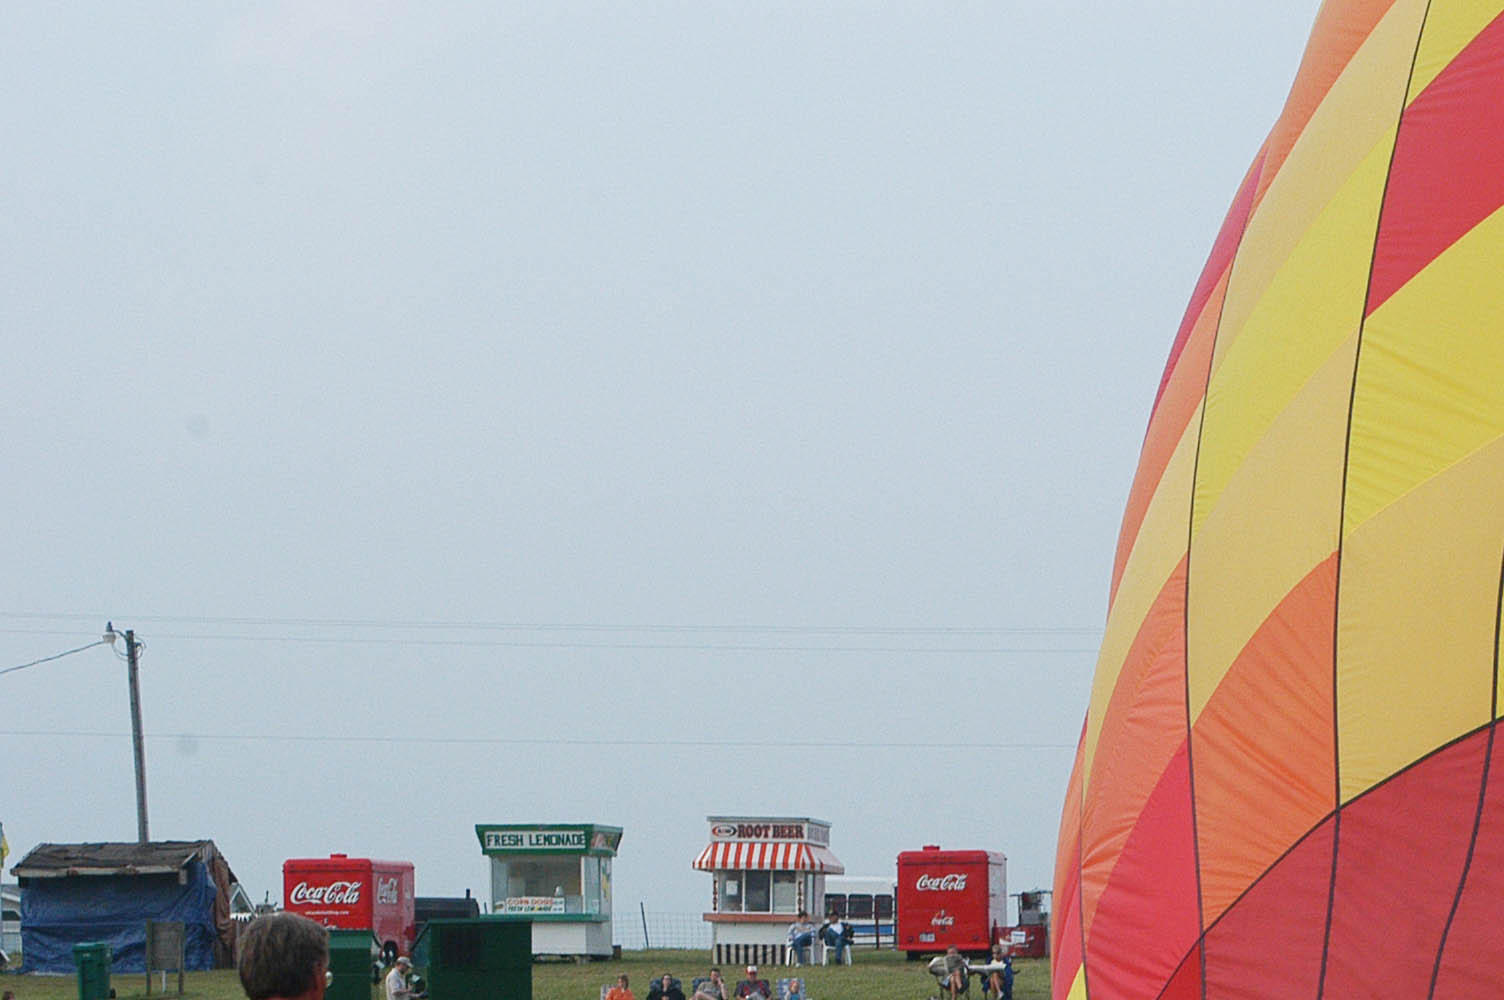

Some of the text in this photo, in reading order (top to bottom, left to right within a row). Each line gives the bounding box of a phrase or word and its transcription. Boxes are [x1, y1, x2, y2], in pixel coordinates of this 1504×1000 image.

[487, 833, 585, 847] FRESH LEMONADE
[737, 824, 771, 839] ROOT
[772, 824, 804, 840] BEER
[916, 873, 968, 891] Coca-Cola
[290, 881, 362, 905] Coca-Cola
